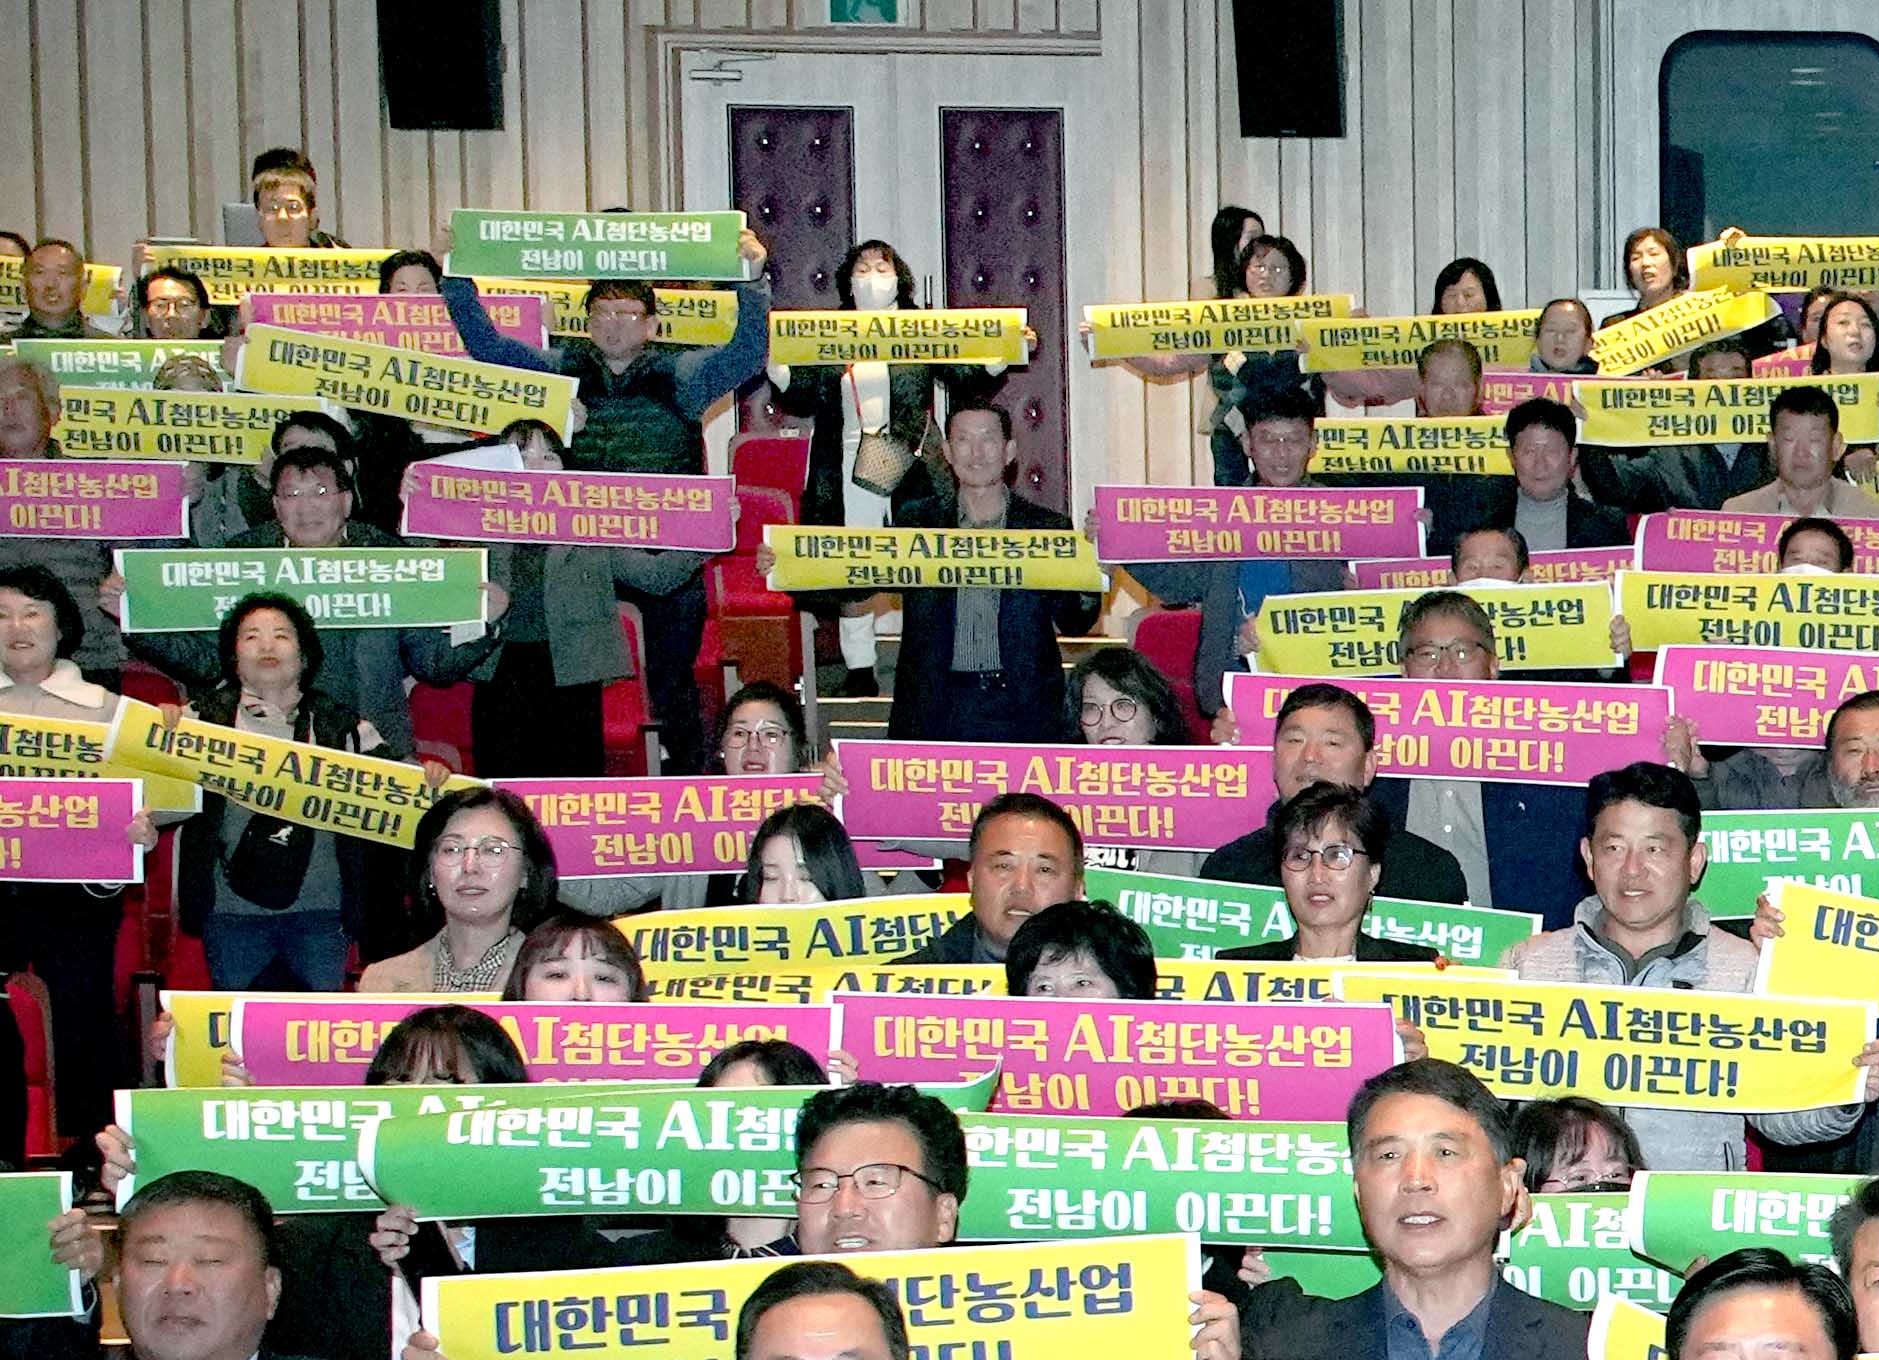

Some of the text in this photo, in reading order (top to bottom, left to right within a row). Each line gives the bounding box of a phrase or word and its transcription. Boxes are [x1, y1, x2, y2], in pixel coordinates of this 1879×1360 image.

[479, 218, 712, 243] 대한민국 AI첨단농산업
[520, 249, 667, 271] 전남이 이끈다!
[1751, 269, 1808, 289] 전남이
[775, 316, 1003, 342] 대한민국 AI첨단농산업
[1110, 299, 1333, 329] 대한민국 AI첨단농산업
[890, 343, 959, 360] 이끈다!
[1223, 325, 1291, 347] 이끈다!
[268, 339, 547, 416] 대한민국 AI첨단농산업
[314, 377, 494, 426] 전남이 이끈다!
[1601, 387, 1696, 410] 대한민국
[431, 474, 713, 513] 대한민국 AI첨단농산업
[1116, 494, 1394, 524] 대한민국 AI첨단농산업
[571, 513, 658, 540] 이끈다!
[1165, 529, 1341, 554] 전남이 이끈다!
[794, 533, 1077, 560] 대한민국 AI첨단농산업
[161, 556, 445, 587] 대한민국 AI첨단농산업
[937, 566, 1023, 587] 이끈다!
[304, 592, 391, 619] 이끈다!
[1646, 583, 1758, 612] 대한민국
[1693, 660, 1828, 700] 대한민국
[1411, 689, 1639, 735] AI첨단농산업
[144, 720, 266, 776] 대한민국
[1450, 736, 1564, 773] 이끈다!
[870, 755, 1248, 798] 대한민국 AI첨단농산업
[301, 793, 409, 838] 이끈다!
[591, 831, 694, 867] 전남이
[634, 924, 793, 966] 대한민국
[873, 1013, 1352, 1068] 대한민국 AI첨단농산업
[1559, 998, 1827, 1054] AI첨단농산업
[1458, 1044, 1739, 1098] 전남이 이끈다!
[446, 1105, 641, 1149] 대한민국
[538, 1167, 681, 1205] 전남이
[1006, 1188, 1332, 1236] 전남이 이끈다!
[494, 1289, 731, 1355] 대한민국
